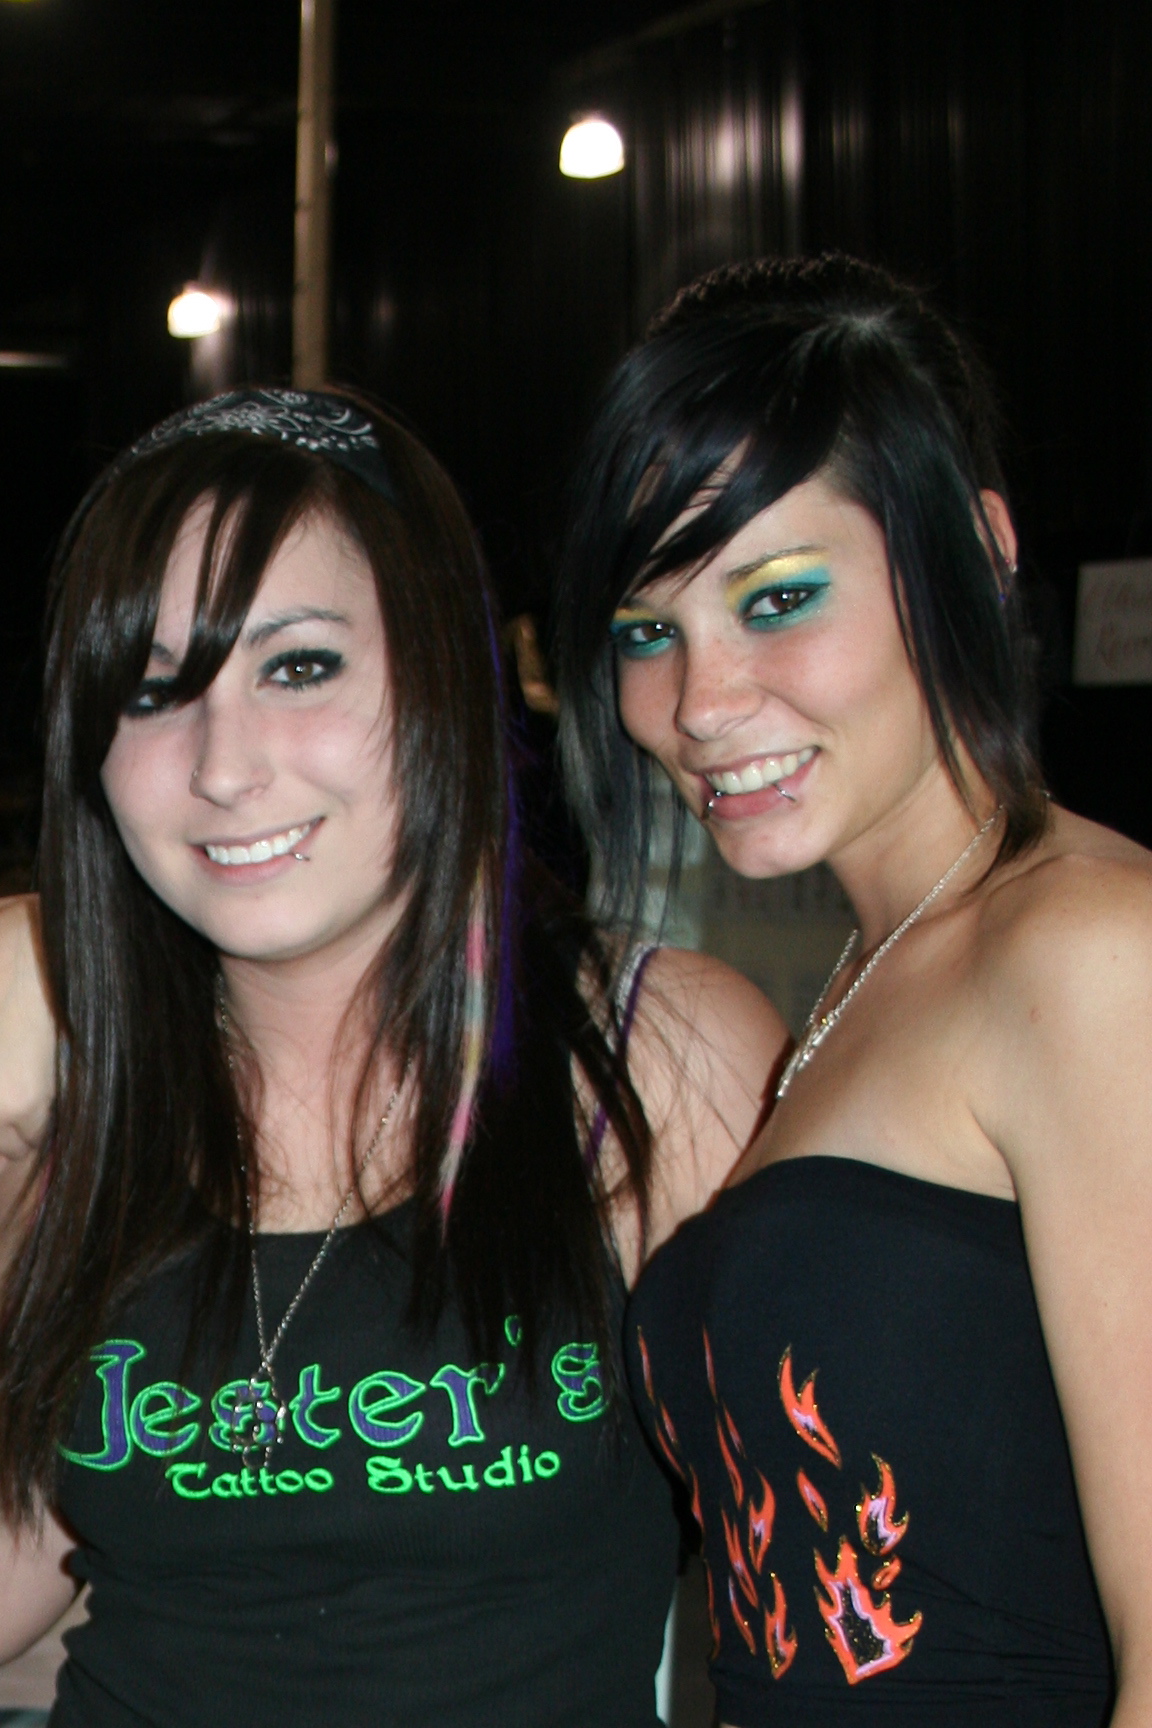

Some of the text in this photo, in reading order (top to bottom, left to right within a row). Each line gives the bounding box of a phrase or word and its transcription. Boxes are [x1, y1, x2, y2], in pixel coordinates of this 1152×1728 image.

[58, 1315, 606, 1471] Jester's
[165, 1445, 560, 1498] Tattoo Studio
